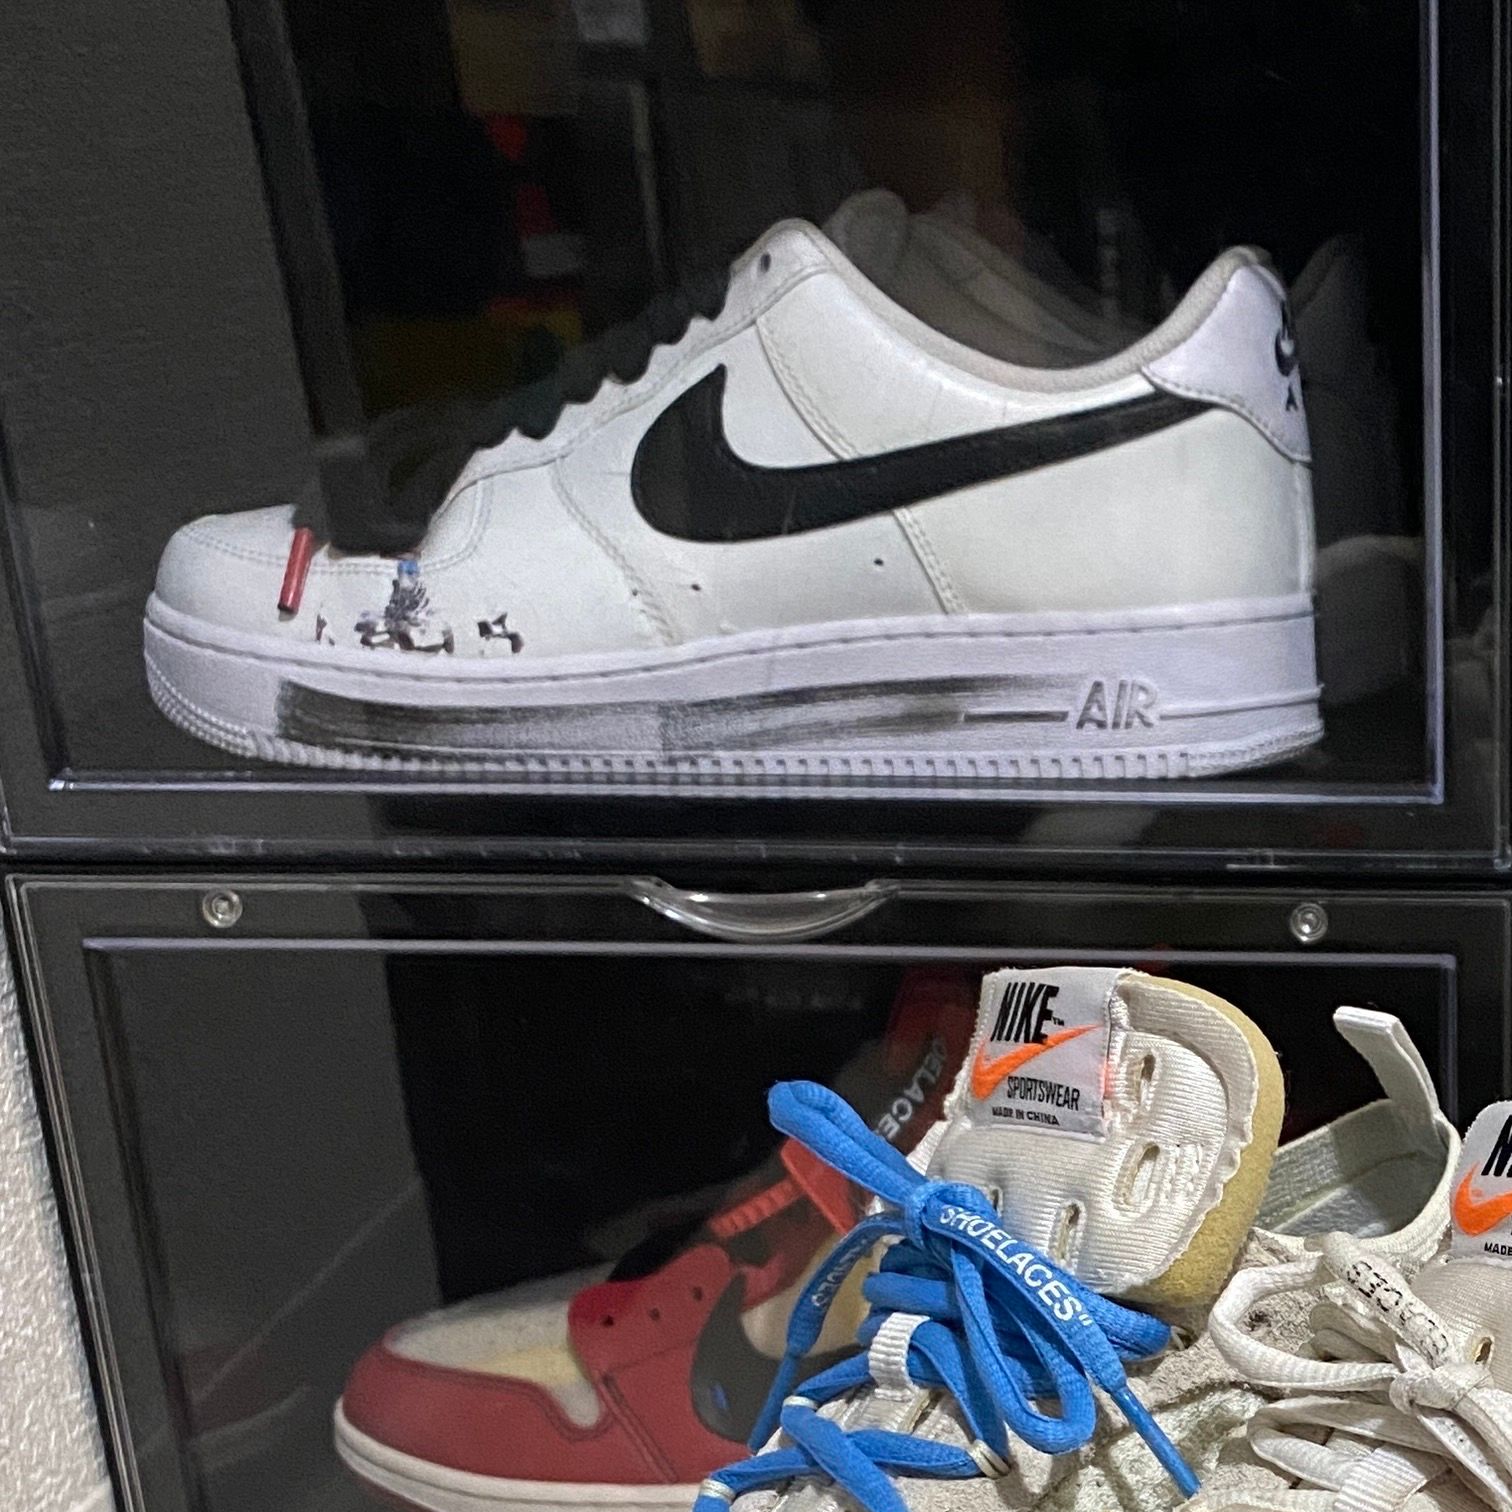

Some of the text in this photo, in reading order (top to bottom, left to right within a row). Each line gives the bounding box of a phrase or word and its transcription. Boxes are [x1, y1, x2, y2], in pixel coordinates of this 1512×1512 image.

[1076, 680, 1158, 730] AIR
[1007, 1075, 1080, 1112] SPORTSWEAR
[1015, 1108, 1025, 1120] IN
[1026, 1110, 1060, 1126] CHINA
